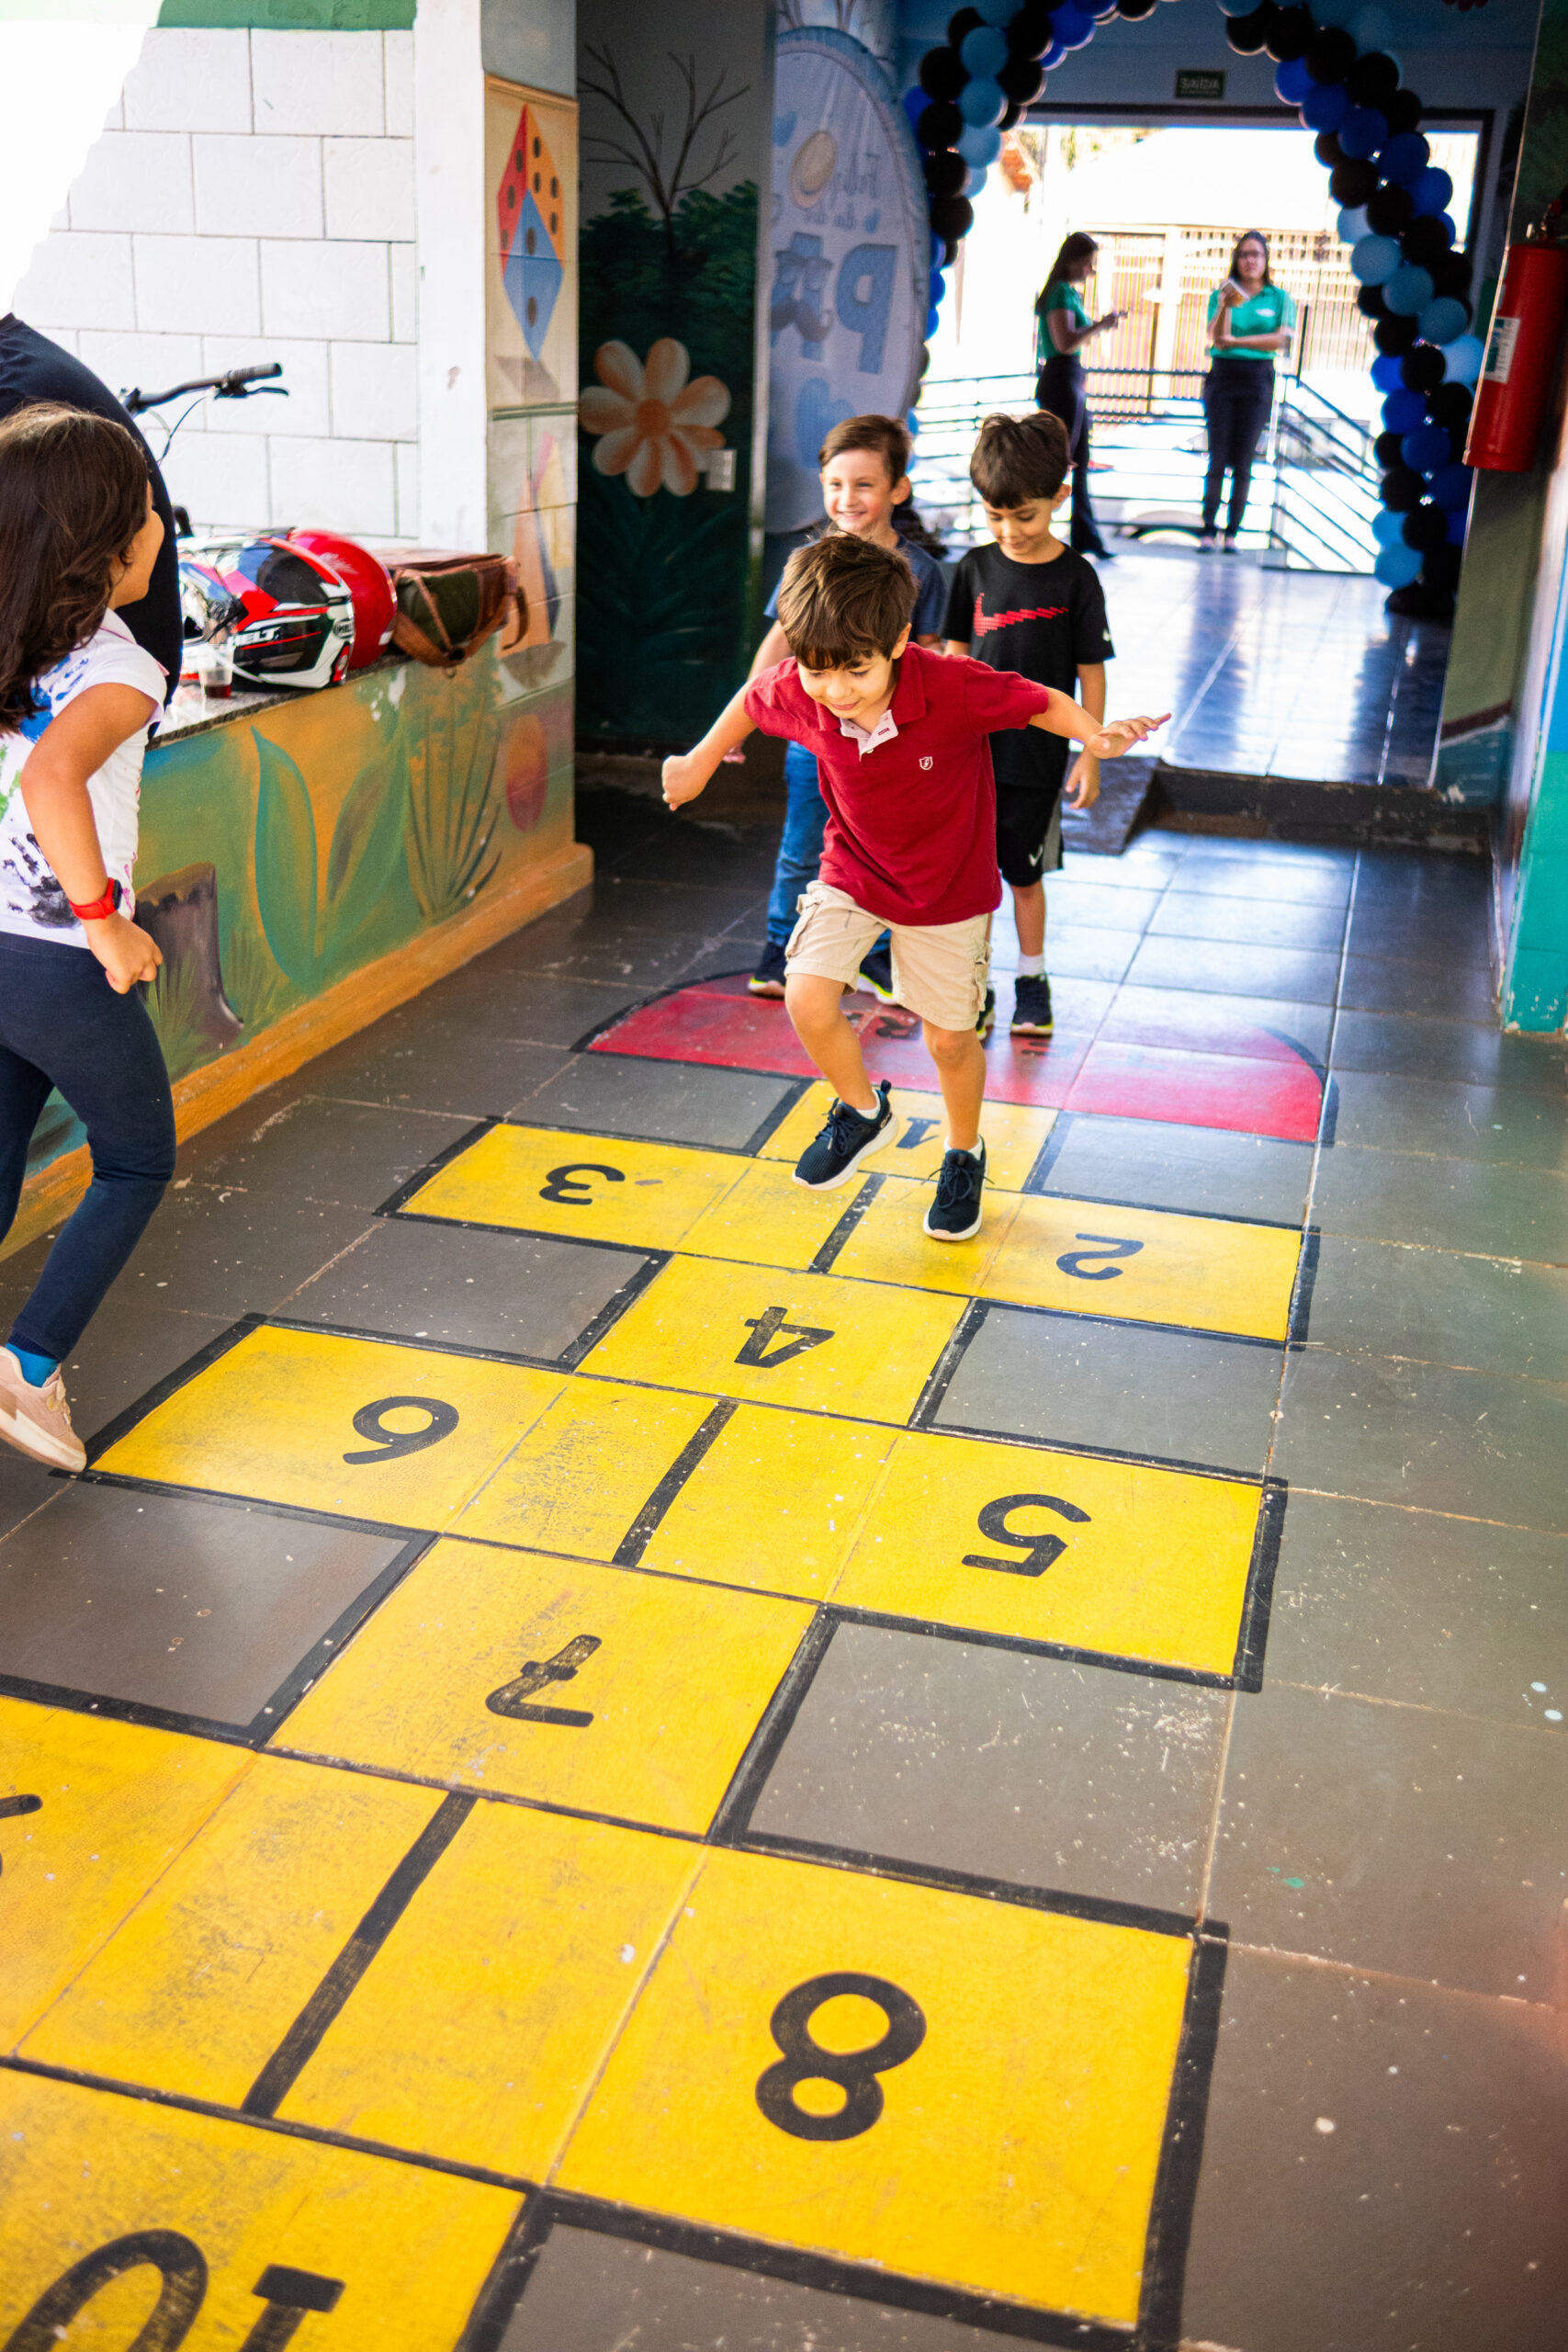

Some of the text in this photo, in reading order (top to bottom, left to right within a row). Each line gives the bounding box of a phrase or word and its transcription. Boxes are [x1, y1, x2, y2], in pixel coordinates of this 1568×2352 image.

[896, 1117, 941, 1149] 1
[539, 1162, 626, 1205] 3
[1056, 1233, 1144, 1281] 2
[734, 1306, 835, 1369] 4
[343, 1396, 459, 1464] 6
[961, 1493, 1091, 1577] 5
[485, 1634, 602, 1728] 7
[755, 1972, 926, 2142] 8
